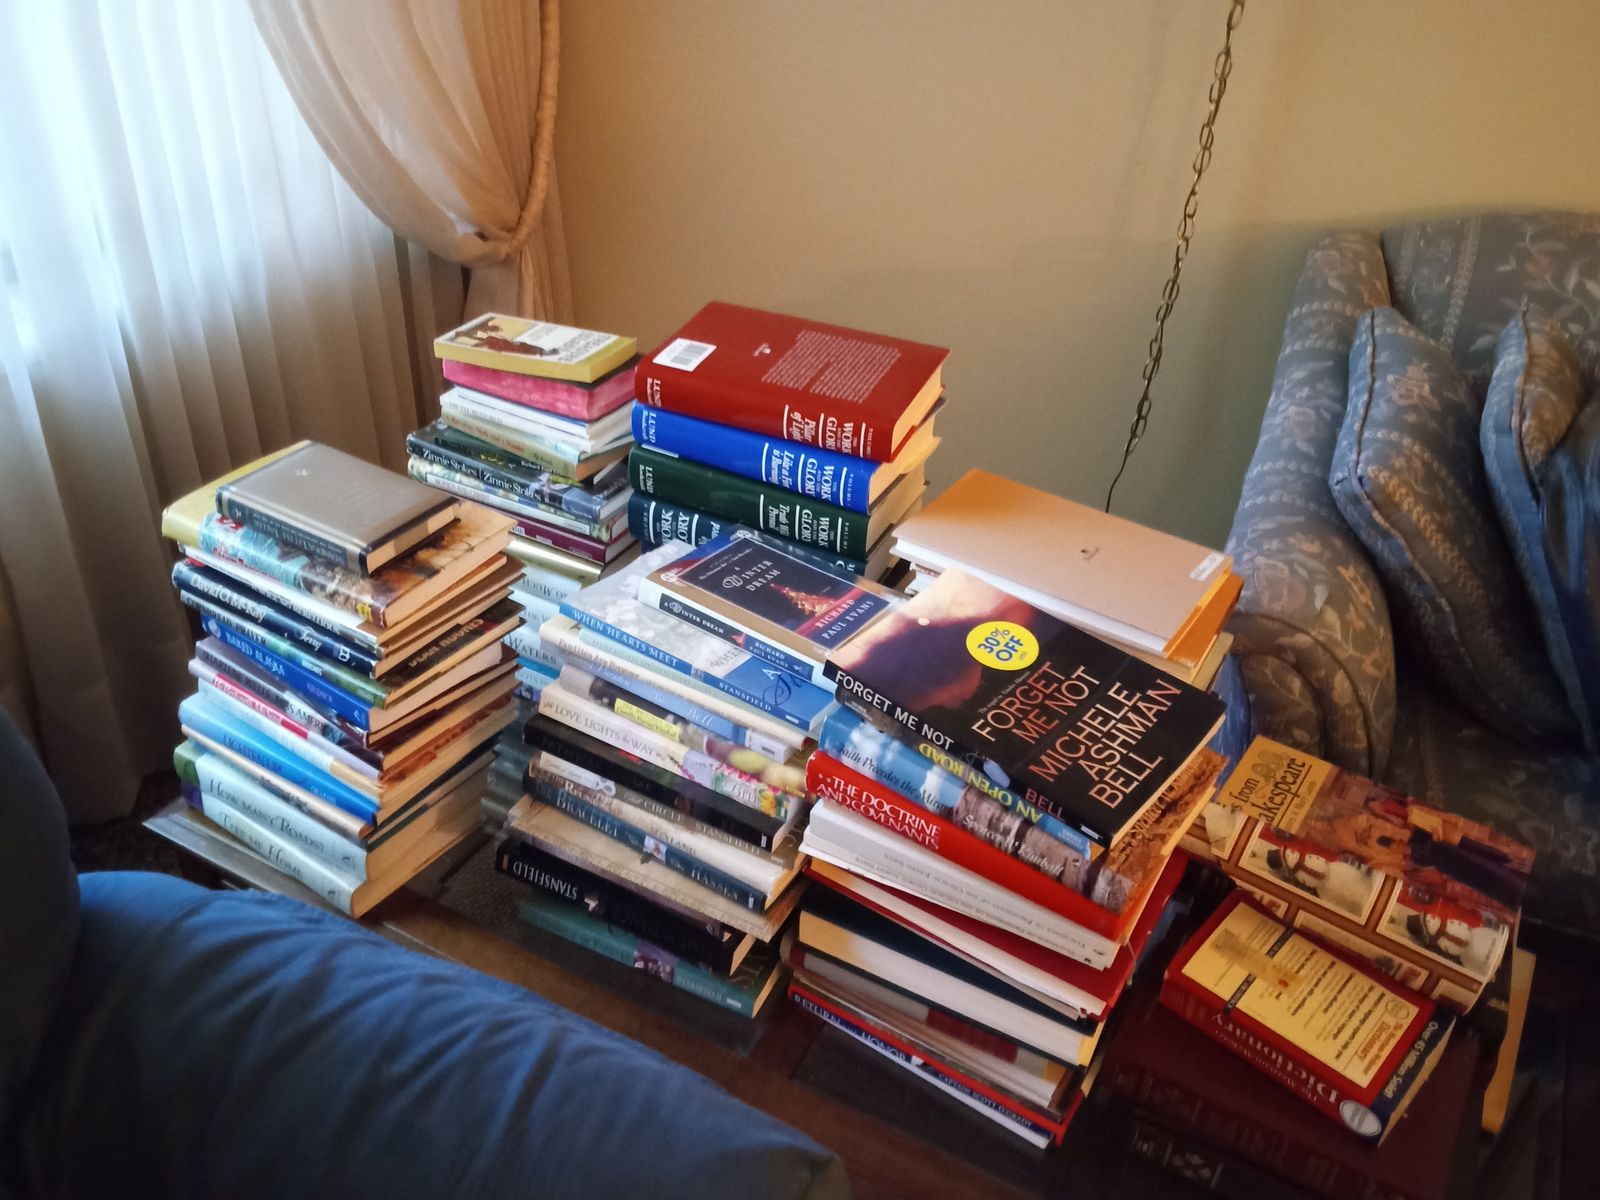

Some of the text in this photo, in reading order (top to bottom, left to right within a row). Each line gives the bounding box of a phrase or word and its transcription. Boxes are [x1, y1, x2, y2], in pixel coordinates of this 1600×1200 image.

[648, 411, 657, 444] LUND
[841, 421, 854, 456] WORK
[422, 448, 478, 479] Zinnie Stokes
[645, 465, 653, 495] LUND
[804, 457, 818, 497] GLORY
[483, 472, 512, 493] Zinnie
[820, 465, 835, 501] WORK
[801, 508, 813, 543] GLORY
[818, 516, 831, 548] WORK
[745, 568, 781, 592] DREAM
[190, 575, 219, 600] David
[230, 594, 266, 623] McKay
[816, 599, 856, 629] RICHARD
[573, 608, 679, 668] WHEN HEARTS MEET
[702, 618, 725, 636] DREAM
[822, 600, 875, 641] PAUL EVANS
[225, 631, 254, 656] BAKED
[254, 649, 286, 676] ALASKA
[507, 634, 557, 665] WATERS
[754, 640, 786, 661] RICHARD
[978, 626, 1012, 654] 30%
[995, 633, 1024, 663] OFF
[718, 681, 772, 713] STANSFIELD
[835, 670, 890, 713] FORGET
[894, 707, 919, 732] ME
[922, 722, 955, 752] NOT
[970, 660, 1066, 742] FORGET
[1011, 665, 1100, 746] ME NOT
[553, 704, 582, 725] LOVE
[583, 717, 621, 743] LIGHTS
[630, 738, 655, 758] WAY
[1027, 681, 1143, 783] MICHELE
[1078, 678, 1184, 783] ASHMAN
[862, 754, 902, 788] Precedes
[918, 742, 1043, 824] AN OPEN ROAD
[1088, 752, 1165, 810] BELL
[831, 775, 941, 836] THE DOCTRINE
[1026, 786, 1067, 824] BELL
[1229, 777, 1260, 804] from
[1249, 757, 1306, 823] akespeare
[556, 789, 619, 838] BRACELET
[643, 801, 682, 823] CIRCLE
[816, 782, 941, 850] AND COVENANTS
[695, 821, 761, 856] STANSFIELD
[962, 813, 1000, 848] Spencer
[1018, 841, 1065, 877] Kimball
[512, 859, 579, 901] STANSFIELD
[1422, 1020, 1439, 1040] Over
[1211, 1013, 1339, 1105] Dictionary
[1214, 1029, 1297, 1089] Merriam-Webster
[1397, 1048, 1420, 1076] Million
